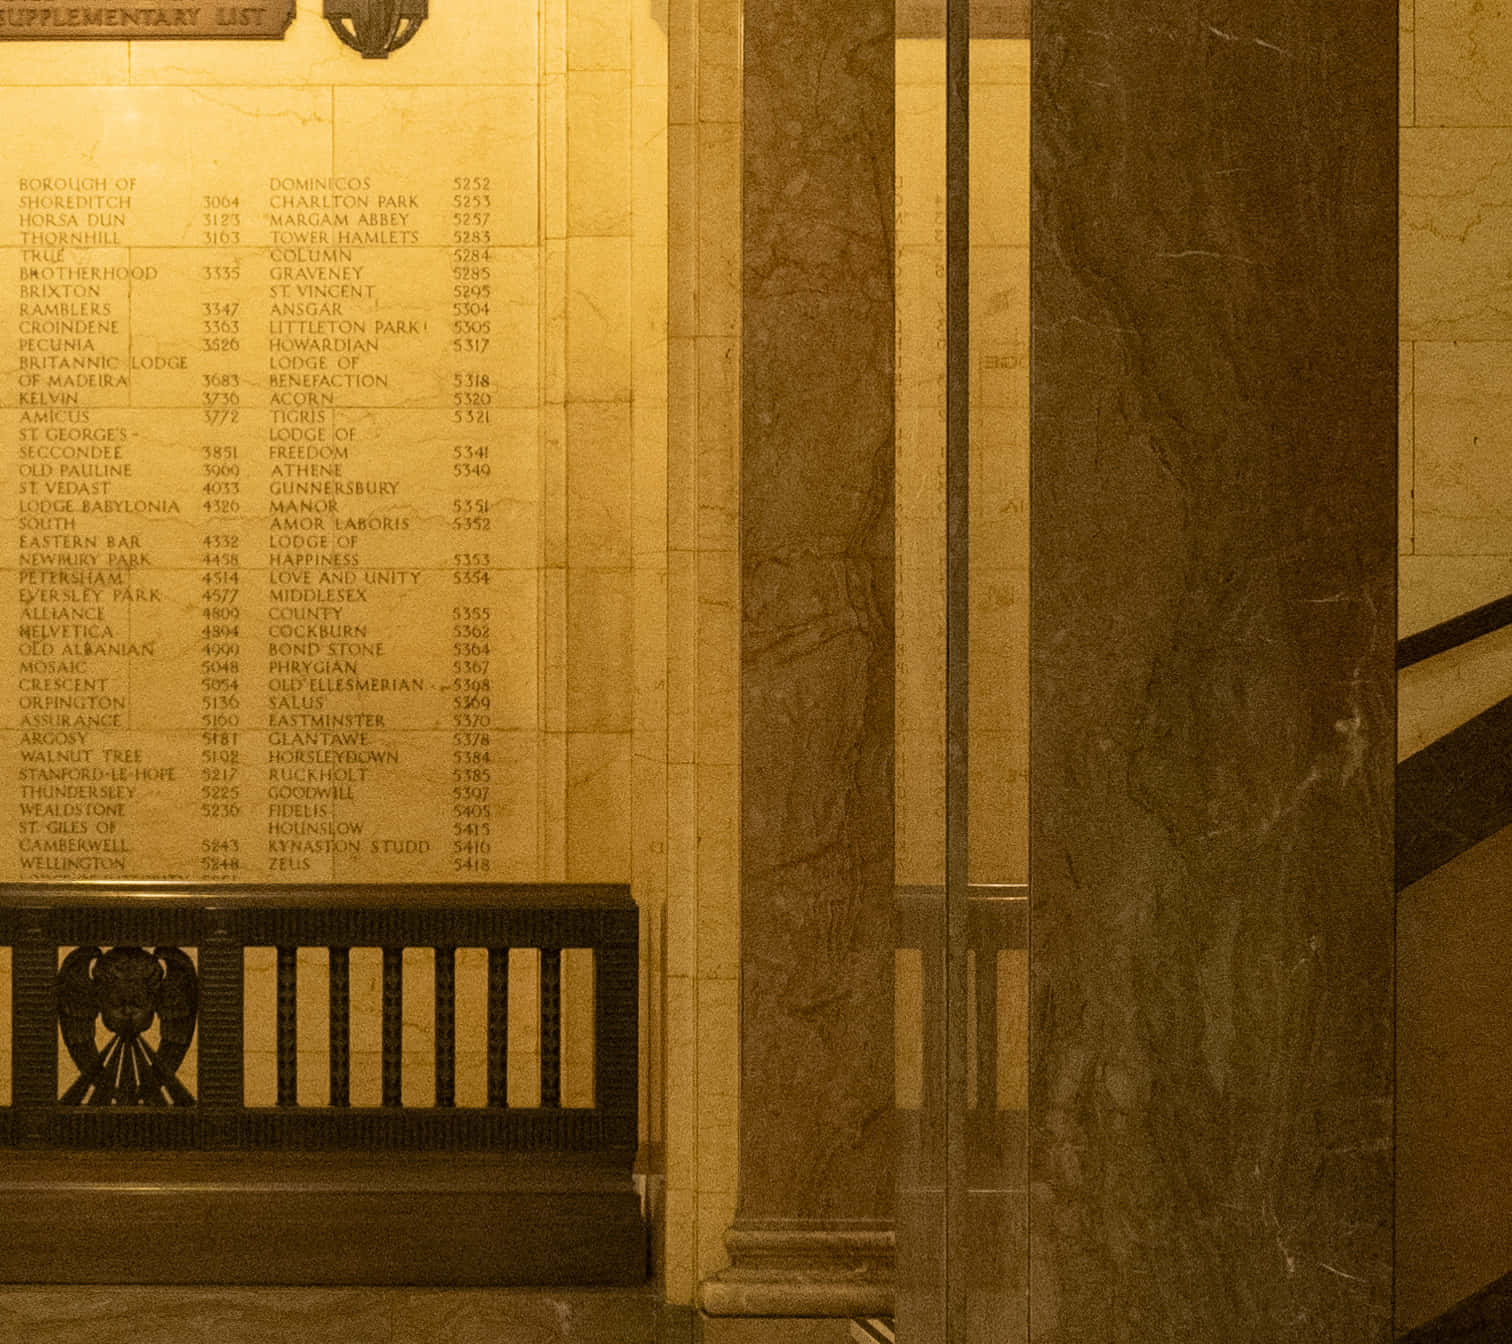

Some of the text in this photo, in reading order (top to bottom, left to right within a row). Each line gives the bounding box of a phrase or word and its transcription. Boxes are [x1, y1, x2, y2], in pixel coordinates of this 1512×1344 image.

[216, 7, 267, 28] LIST
[452, 177, 490, 191] 5252
[18, 196, 132, 210] SHOREDITCH
[269, 195, 369, 209] CHARLTON
[377, 195, 419, 209] PARK
[19, 213, 79, 228] HORSA
[87, 213, 126, 228] DUN
[269, 212, 490, 227] MARGAM ABBEY 5257
[19, 231, 120, 246] THORNHILL
[269, 230, 329, 244] TOWER
[338, 230, 420, 244] HAMLETS
[269, 248, 490, 263] COLUMN 5284
[269, 266, 490, 281] GRAVENEY 5285
[270, 302, 490, 316] ANSGAR 5304
[269, 320, 366, 334] LITTLETON
[375, 320, 419, 334] PARK
[269, 338, 490, 352] HOWARDIAN 5317
[269, 374, 389, 388] BENEFACTION
[269, 446, 349, 460] FREEDOM
[269, 571, 312, 585] LOVE
[318, 571, 357, 585] AND
[364, 571, 421, 585] UNITY
[268, 624, 368, 639] COCKBURN
[268, 642, 319, 657] BOND
[327, 642, 385, 657] STONE
[268, 839, 361, 854] KYNASTON
[370, 839, 430, 854] STUDD
